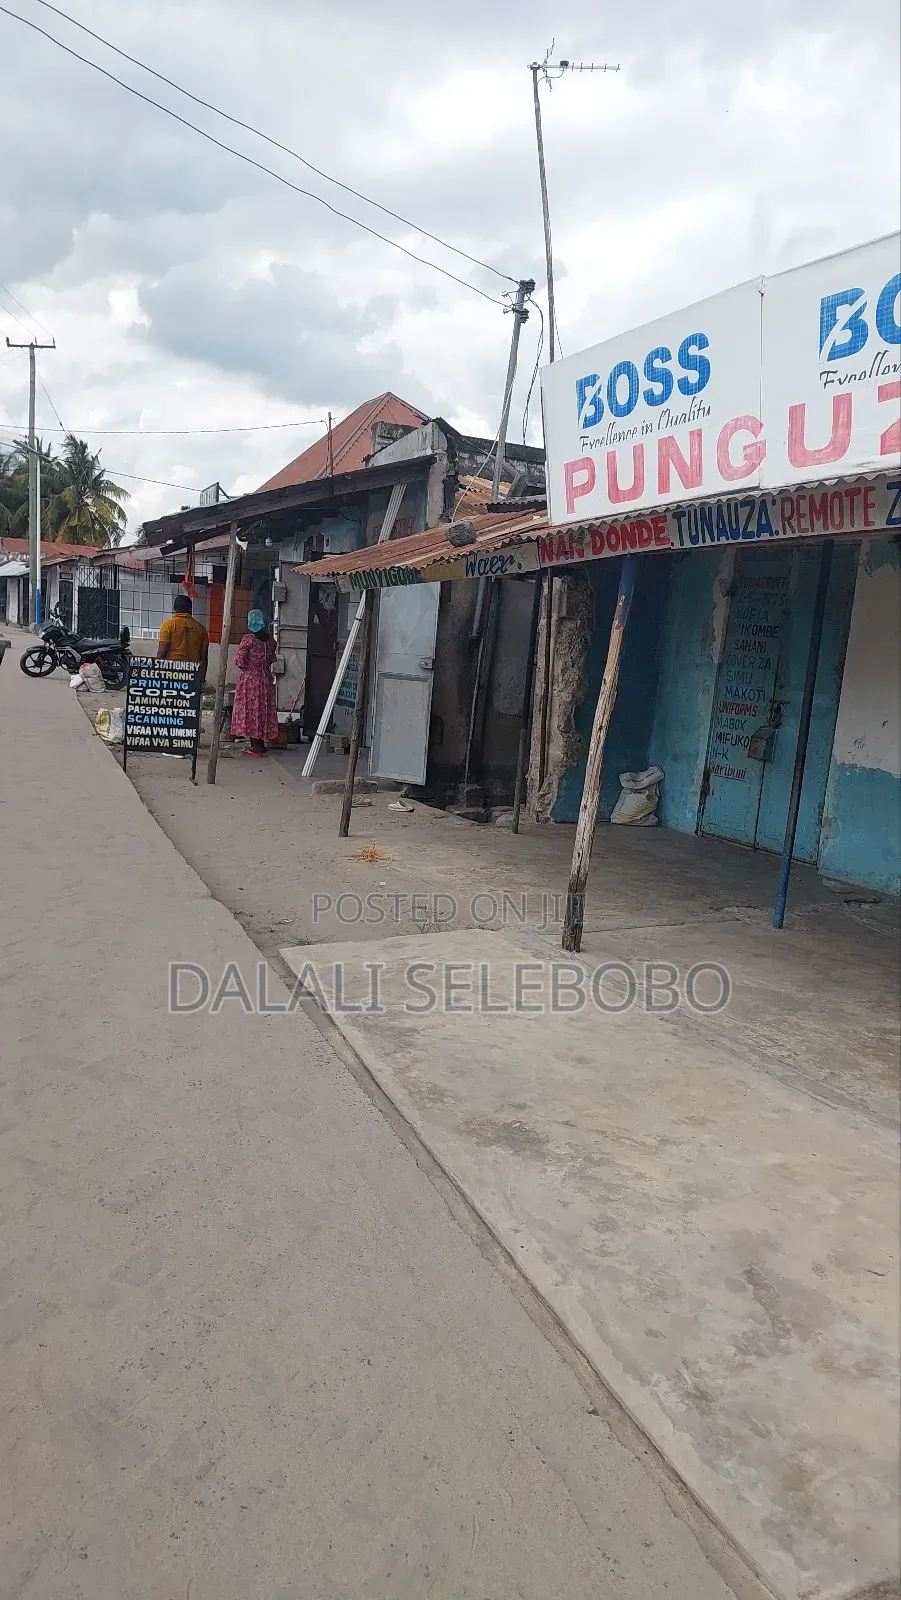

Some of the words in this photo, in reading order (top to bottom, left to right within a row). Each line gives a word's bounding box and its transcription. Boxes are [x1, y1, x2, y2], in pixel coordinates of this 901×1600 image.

[575, 332, 711, 430] BOSS
[640, 419, 653, 436] in
[781, 486, 876, 535] REMOTE
[733, 640, 767, 653] SAHANI
[154, 659, 200, 672] STATIONERY
[758, 656, 771, 671] ZA
[141, 669, 194, 681] ELECTRONIC
[726, 670, 752, 686] SIMU
[130, 679, 188, 690] PRINTING
[129, 687, 196, 699] COPY
[724, 686, 766, 702] MAKOTI
[128, 696, 190, 707] LAMINATION
[719, 701, 757, 717] UNIFORMS
[127, 715, 184, 726] SCANNING
[716, 716, 747, 731] MABOX
[127, 725, 151, 735] VIFAA
[153, 727, 168, 737] VYA
[170, 728, 196, 738] UMEME
[126, 737, 150, 746] VIFAA
[152, 738, 169, 748] VYA
[172, 739, 194, 748] SIMU
[715, 731, 750, 748] MIFUKO
